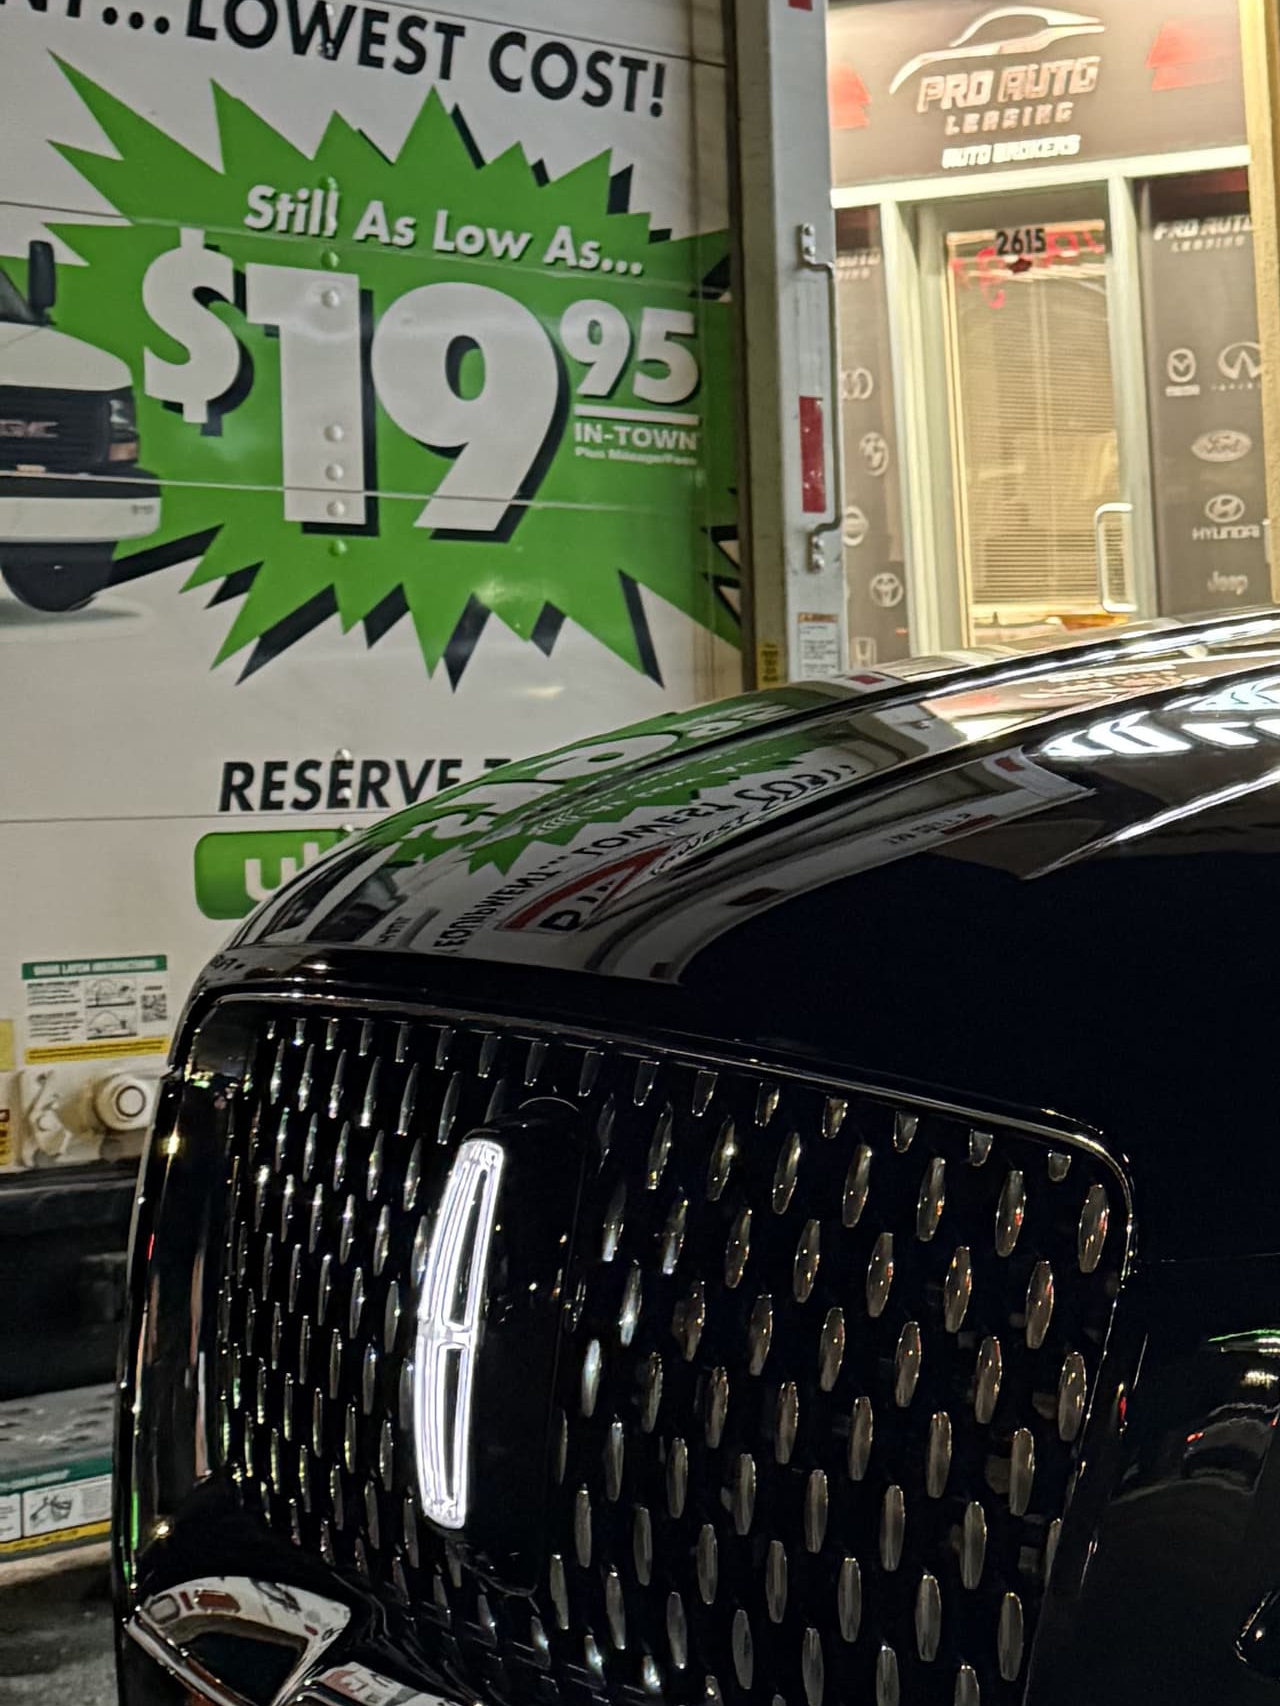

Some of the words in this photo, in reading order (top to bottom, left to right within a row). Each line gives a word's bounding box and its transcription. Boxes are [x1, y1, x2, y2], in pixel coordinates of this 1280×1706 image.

[487, 30, 668, 120] COST!
[917, 70, 991, 113] PRO
[997, 54, 1102, 103] AUTO
[944, 100, 1074, 137] LEASING
[243, 181, 341, 239] Still
[352, 198, 418, 253] As
[431, 208, 534, 265] Low
[543, 223, 645, 278] As...
[995, 227, 1047, 256] 2615
[574, 422, 698, 452] IN-TOWN
